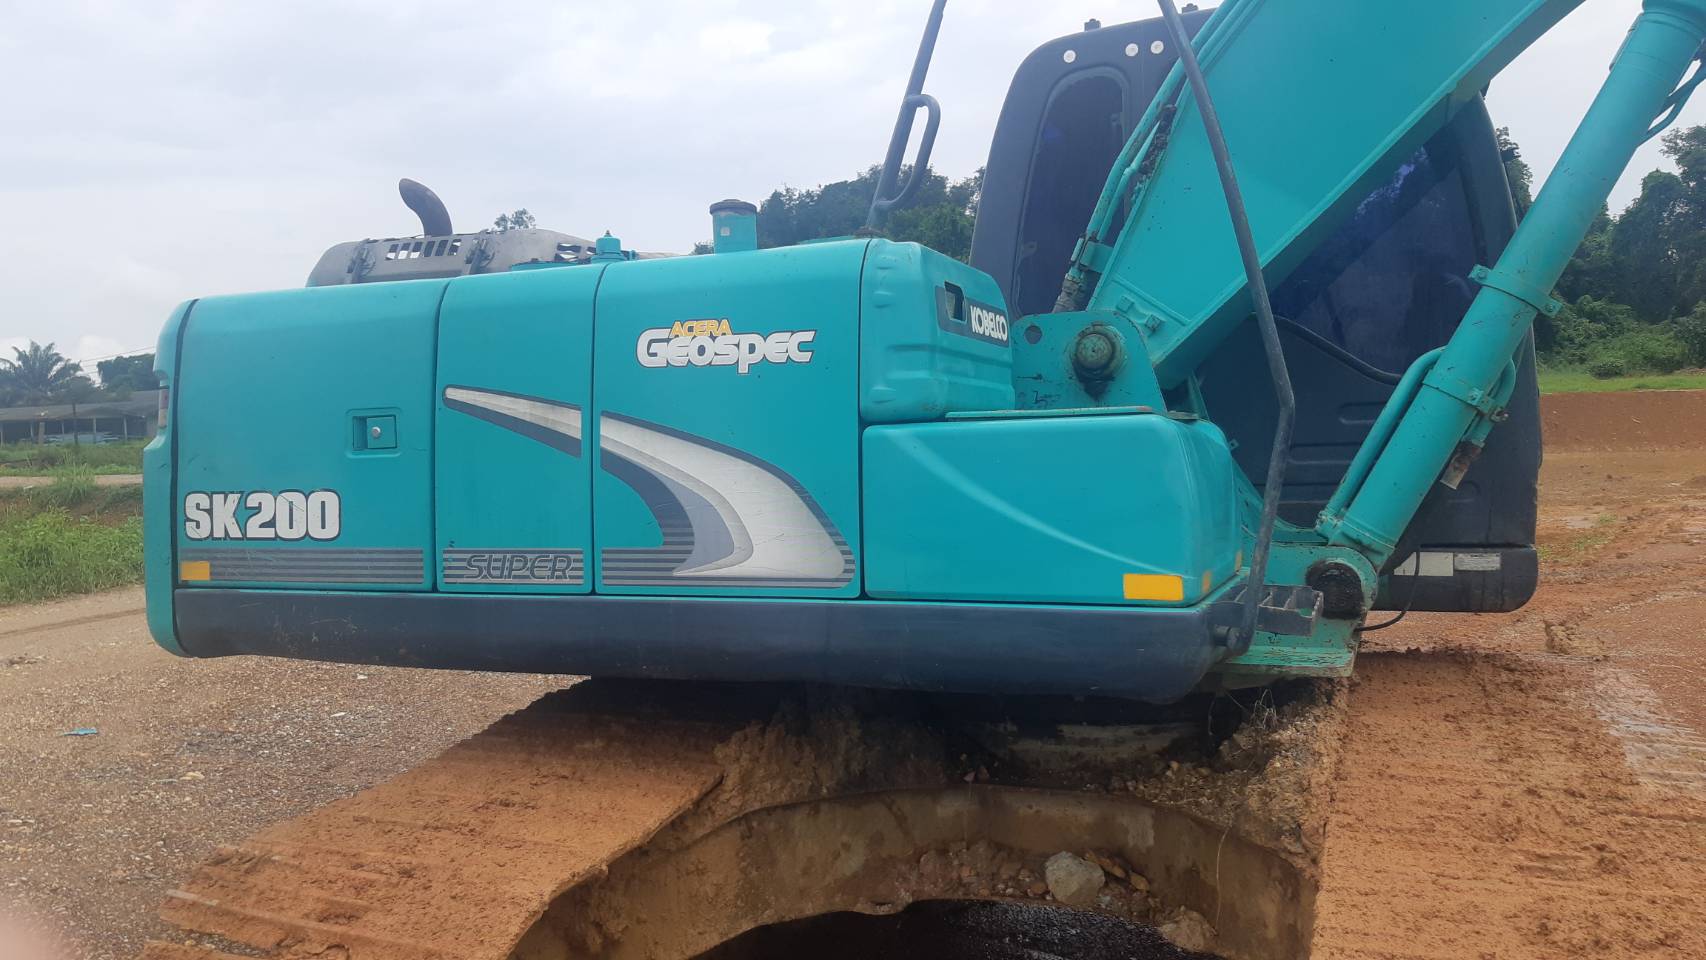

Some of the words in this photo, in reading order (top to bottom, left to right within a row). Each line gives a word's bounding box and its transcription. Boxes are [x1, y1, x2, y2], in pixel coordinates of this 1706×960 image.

[669, 319, 733, 338] ACERA
[969, 305, 1008, 342] KOBELCO
[185, 491, 340, 539] SK200
[464, 553, 573, 581] SUPER
